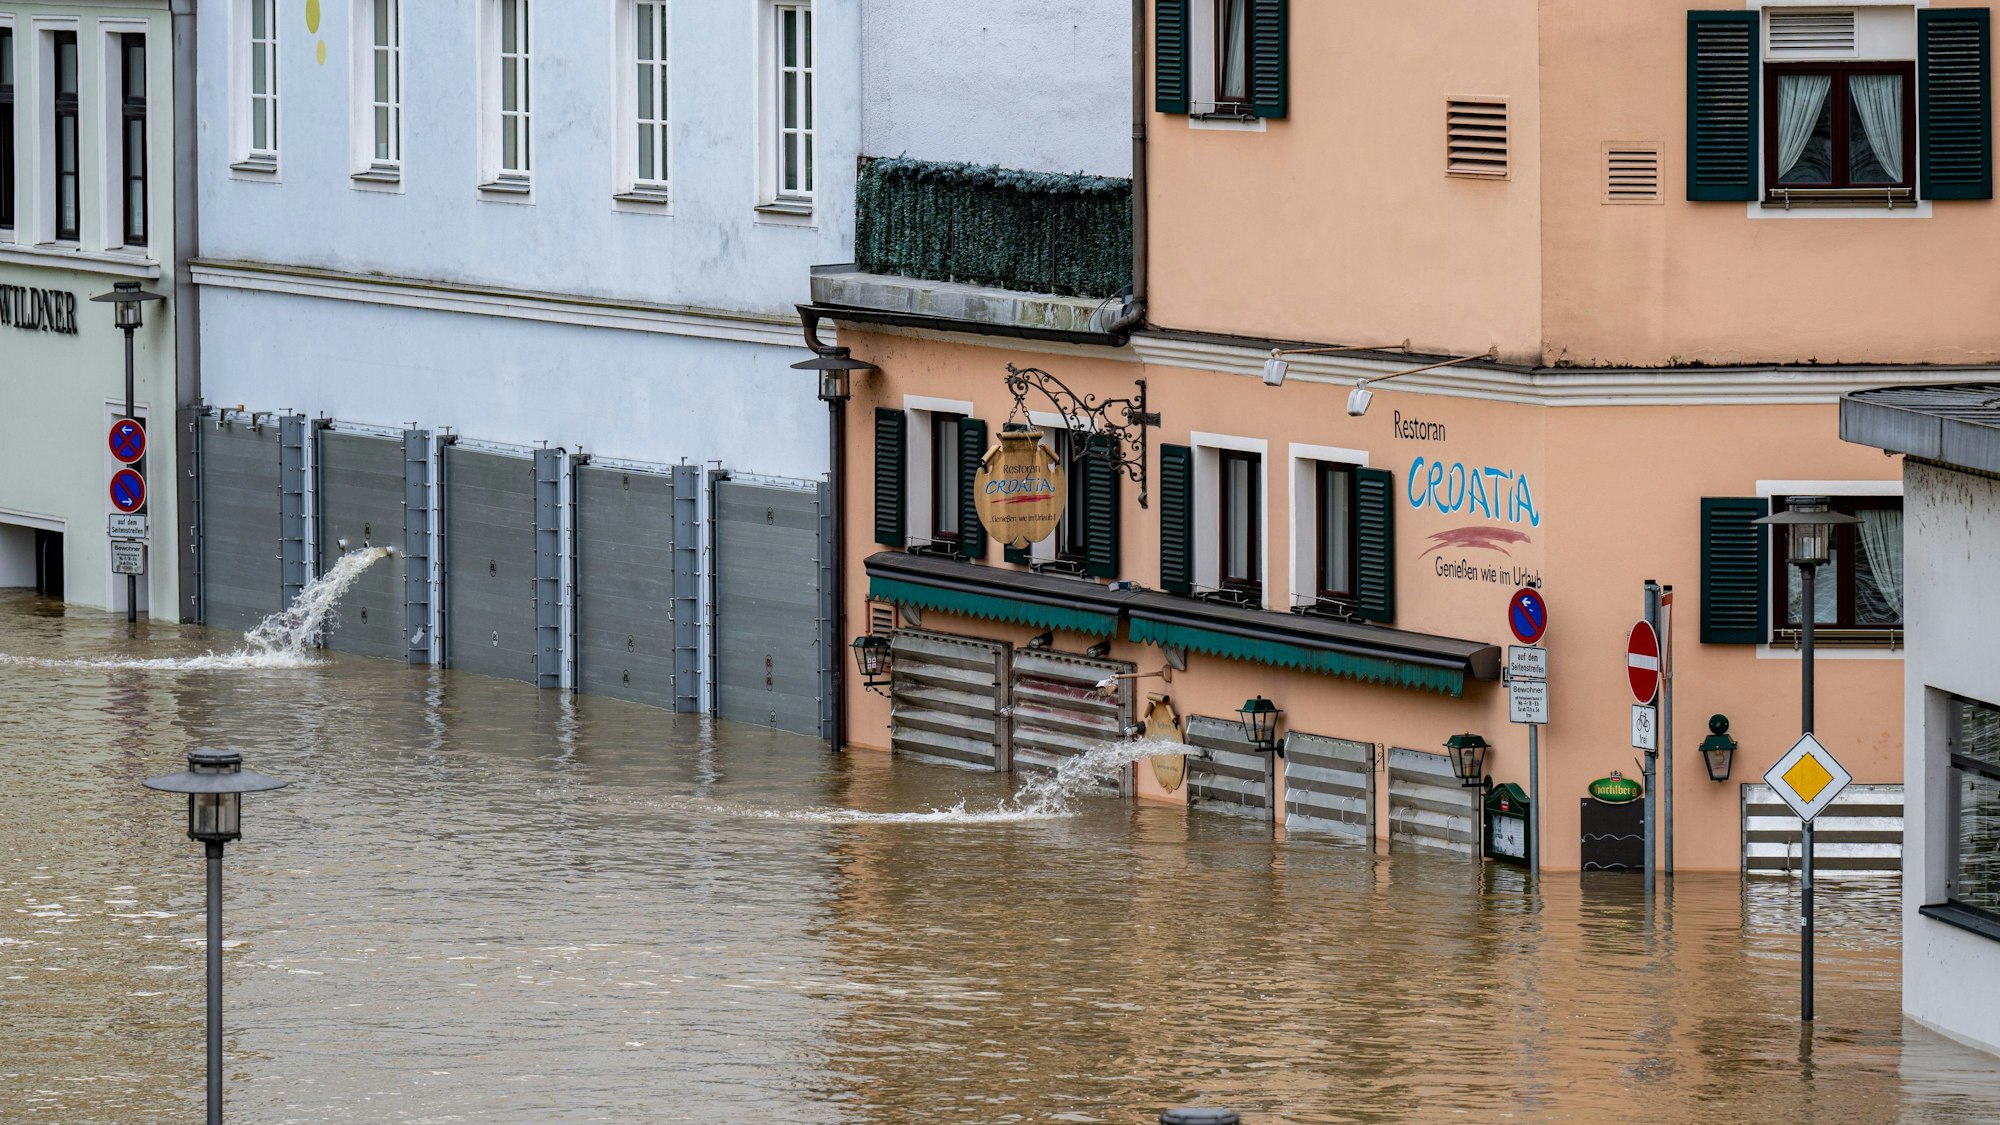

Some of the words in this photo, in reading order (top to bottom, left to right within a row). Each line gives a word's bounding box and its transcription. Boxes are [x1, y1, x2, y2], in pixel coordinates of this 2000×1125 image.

[1393, 410, 1446, 441] Restoran
[1003, 464, 1041, 474] Restoran
[111, 526, 143, 534] Seitenstreifen
[1435, 556, 1478, 581] Genießen
[1480, 563, 1497, 584] wie
[1500, 565, 1511, 586] im
[1518, 652, 1526, 661] auf
[1528, 653, 1538, 662] dem
[1510, 662, 1545, 674] Seitenstreifen
[1513, 685, 1544, 694] Bewohner
